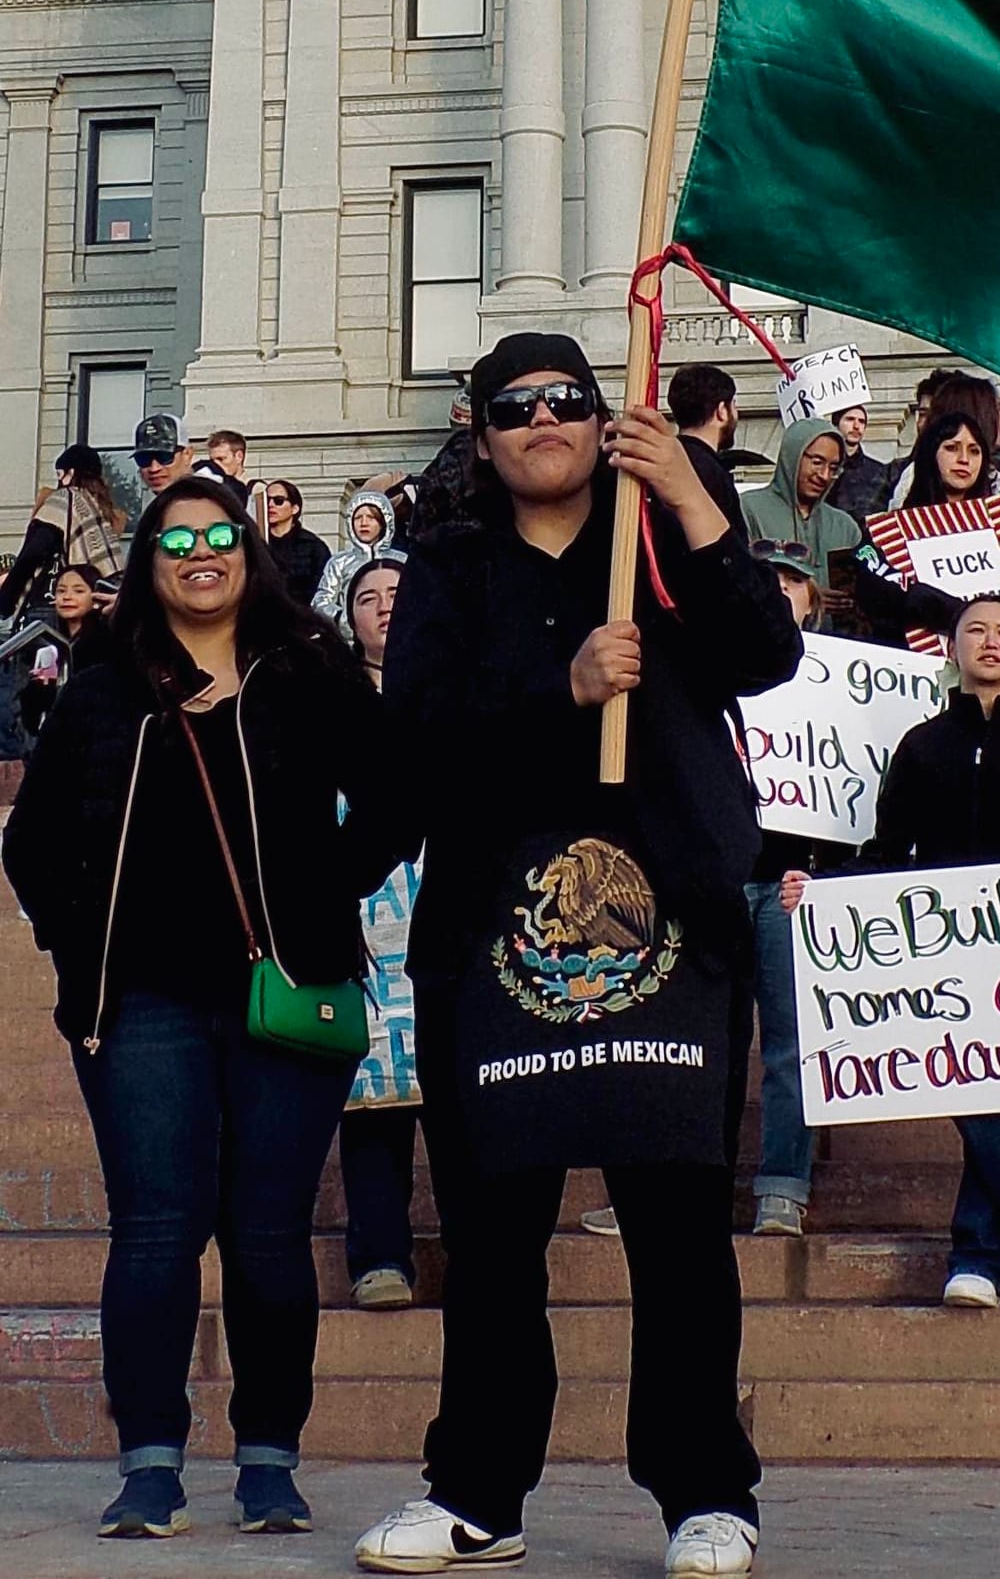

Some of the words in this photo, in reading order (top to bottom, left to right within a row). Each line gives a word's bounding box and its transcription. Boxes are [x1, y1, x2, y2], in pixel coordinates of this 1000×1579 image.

[786, 366, 867, 422] TRUMP!
[931, 550, 995, 578] FUCK
[847, 659, 942, 707] goin
[799, 902, 903, 972] We
[478, 1053, 546, 1086] PROUD
[550, 1048, 576, 1072] TO
[580, 1042, 607, 1067] BE
[612, 1039, 704, 1068] MEXICAN
